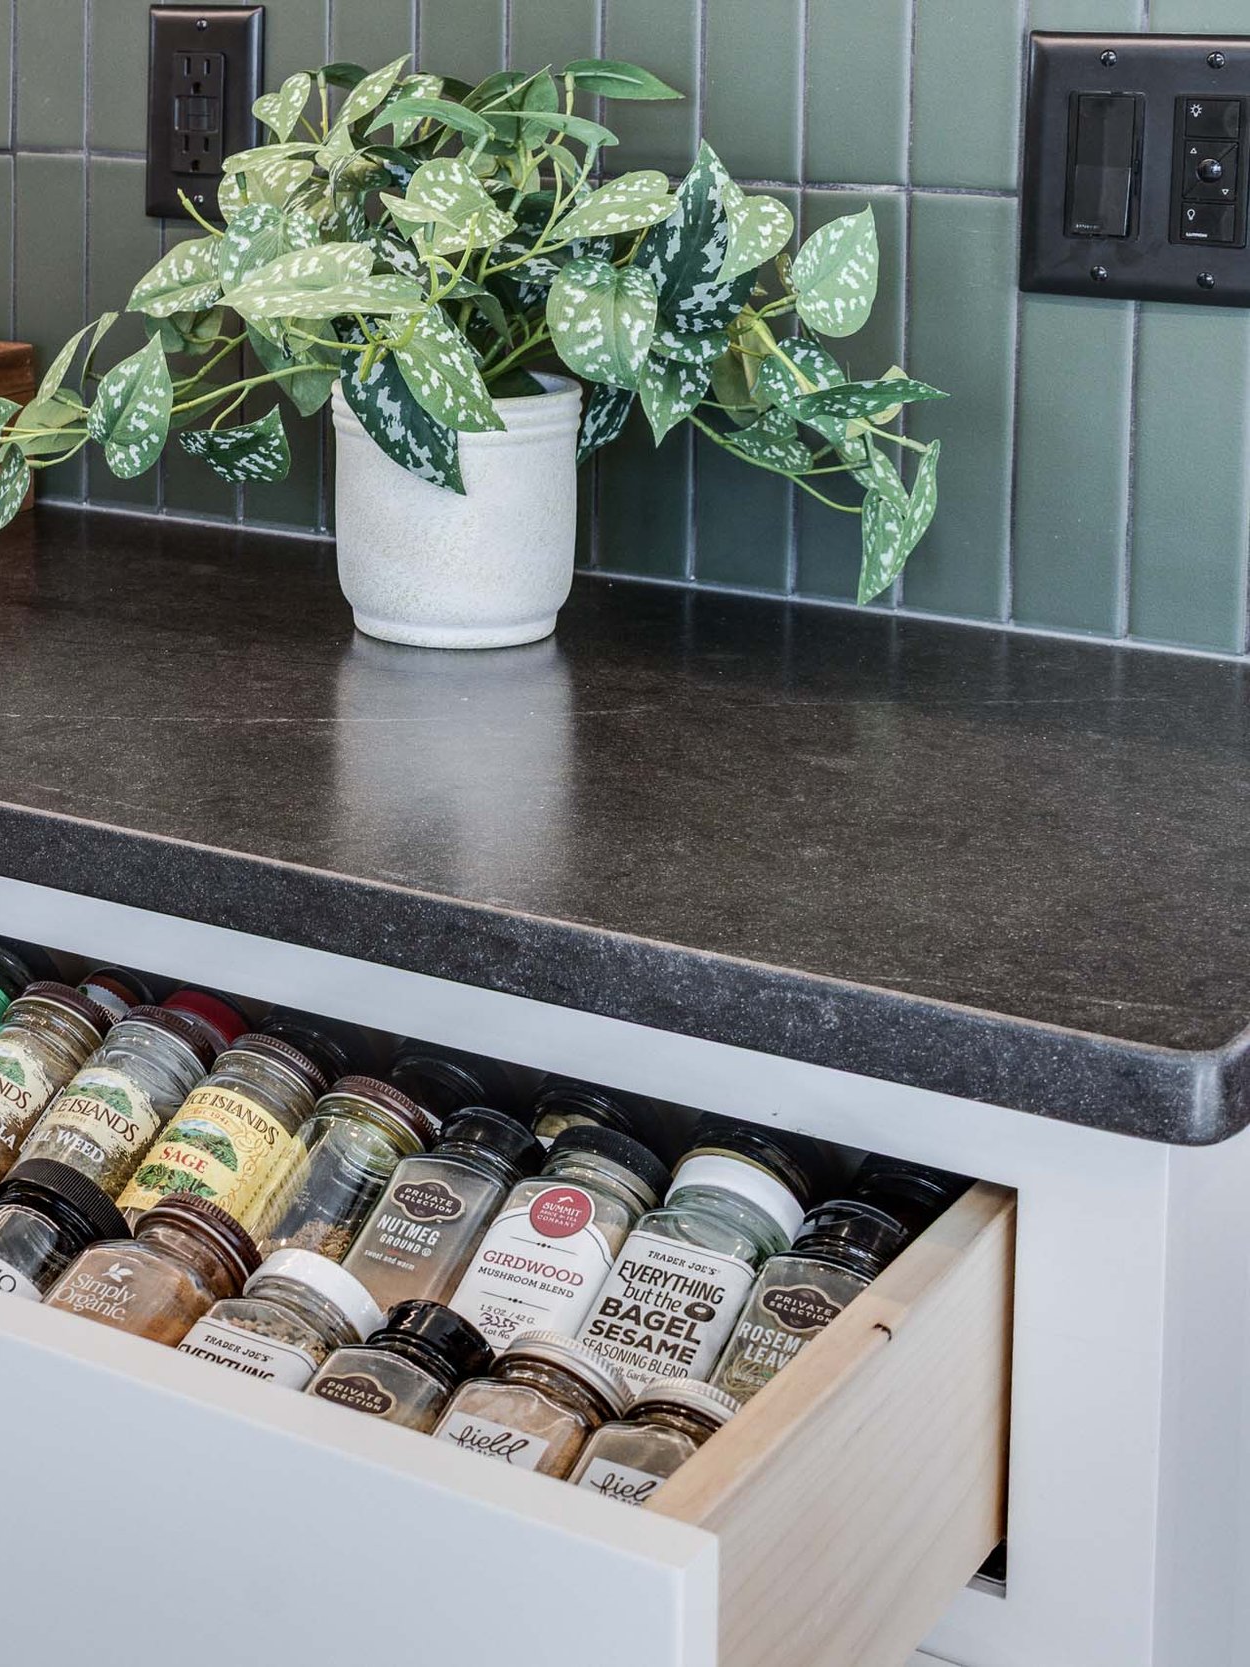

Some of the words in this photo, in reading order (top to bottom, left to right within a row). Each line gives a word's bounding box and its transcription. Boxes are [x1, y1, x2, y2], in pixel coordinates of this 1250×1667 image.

[68, 1098, 140, 1143] ISLANDS
[209, 1094, 280, 1146] ISLANDS
[56, 1129, 105, 1163] WEED
[159, 1146, 209, 1174] SAGE
[398, 1193, 453, 1214] SELECTION
[404, 1187, 454, 1208] PRIVATE
[542, 1201, 582, 1217] SUMMIT
[376, 1213, 441, 1246] NUTMEG
[537, 1214, 576, 1228] COMPANY
[379, 1233, 422, 1254] GROUND
[383, 1255, 398, 1264] and
[396, 1260, 415, 1271] warm
[483, 1250, 584, 1287] GIRDWOOD
[648, 1250, 686, 1268] TRADER
[687, 1262, 718, 1276] JOE'S
[71, 1272, 137, 1306] Simply
[478, 1266, 538, 1288] MUSHROOM
[539, 1282, 575, 1299] BLEND
[617, 1260, 726, 1305] EVERYTHING
[622, 1280, 655, 1305] but
[653, 1291, 682, 1312] the
[55, 1286, 127, 1321] Organic
[480, 1304, 493, 1312] 1.5
[515, 1312, 526, 1321] 42
[769, 1300, 831, 1322] SELECTION
[774, 1293, 833, 1316] PRIVATE
[483, 1327, 497, 1337] Lot
[598, 1296, 701, 1346] BAGEL
[204, 1334, 241, 1354] TRADER
[242, 1348, 271, 1362] JOE'S
[588, 1319, 697, 1366] SESAME
[738, 1320, 802, 1354] ROSEM
[582, 1337, 648, 1369] SEASONING
[647, 1358, 689, 1379] BLEND
[743, 1343, 791, 1370] LEAV
[320, 1387, 382, 1412] SELECTION
[326, 1381, 383, 1404] PRIVATE
[449, 1425, 530, 1464] field
[590, 1472, 658, 1504] fiel
